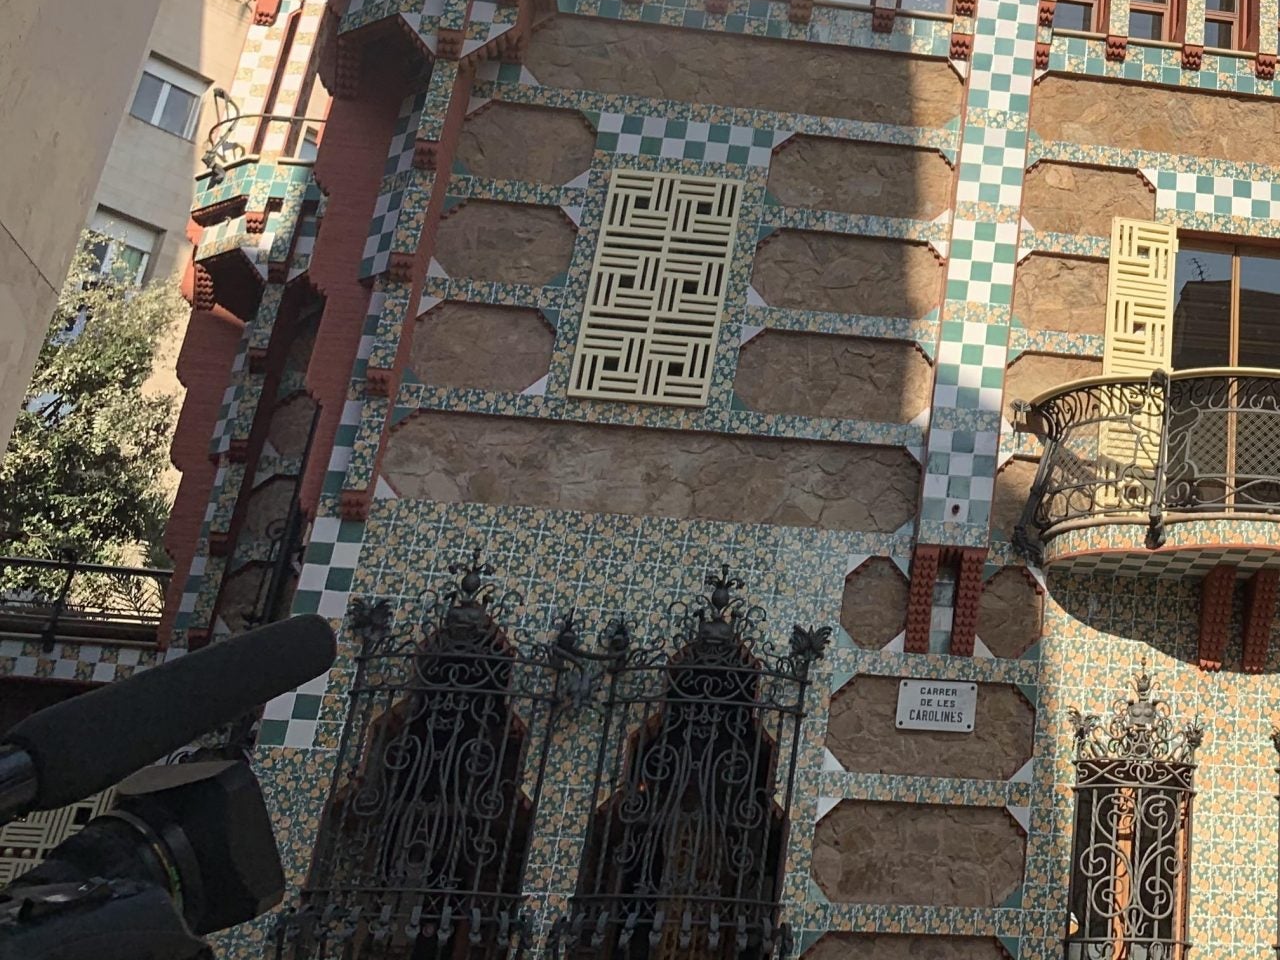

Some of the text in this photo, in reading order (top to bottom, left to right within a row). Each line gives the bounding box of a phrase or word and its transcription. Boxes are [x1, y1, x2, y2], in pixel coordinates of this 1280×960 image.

[920, 687, 958, 697] CARRER
[920, 698, 957, 708] DE LES
[909, 709, 963, 723] CAROLINES
